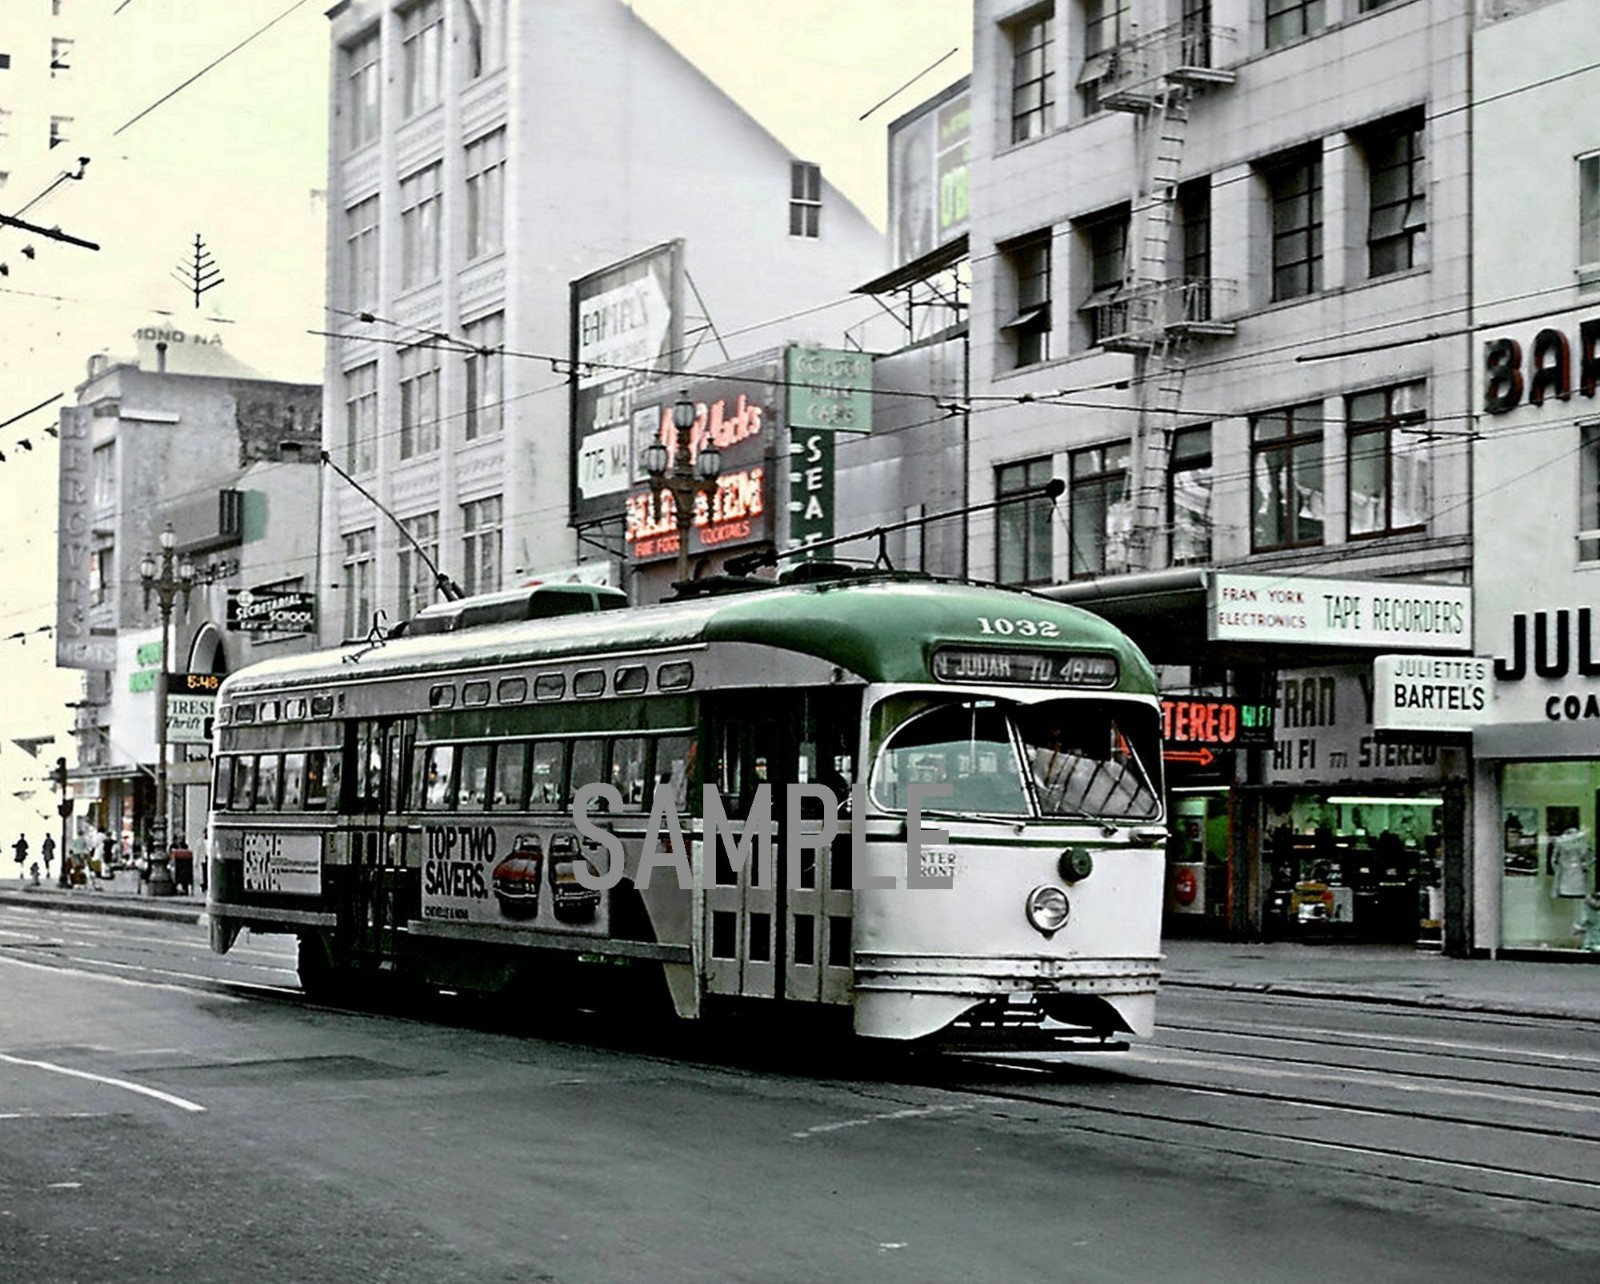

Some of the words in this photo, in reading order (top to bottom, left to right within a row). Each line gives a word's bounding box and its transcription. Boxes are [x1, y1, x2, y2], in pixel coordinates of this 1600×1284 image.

[1222, 588, 1257, 602] FRAN
[1269, 590, 1304, 605] YORK
[269, 610, 313, 623] SCHOOL
[1219, 612, 1307, 629] ELECTRONICS
[1324, 594, 1361, 630] TAPE
[1373, 597, 1464, 635] RECORDERS
[977, 617, 1060, 638] 1032
[956, 654, 1011, 678] JUDAH
[1394, 660, 1485, 681] JULIETTES
[187, 675, 218, 690] 5:48
[1394, 684, 1485, 711] BARTEL'S
[426, 826, 457, 860] TOP
[458, 827, 497, 863] TWO
[425, 861, 489, 899] SAVERS.
